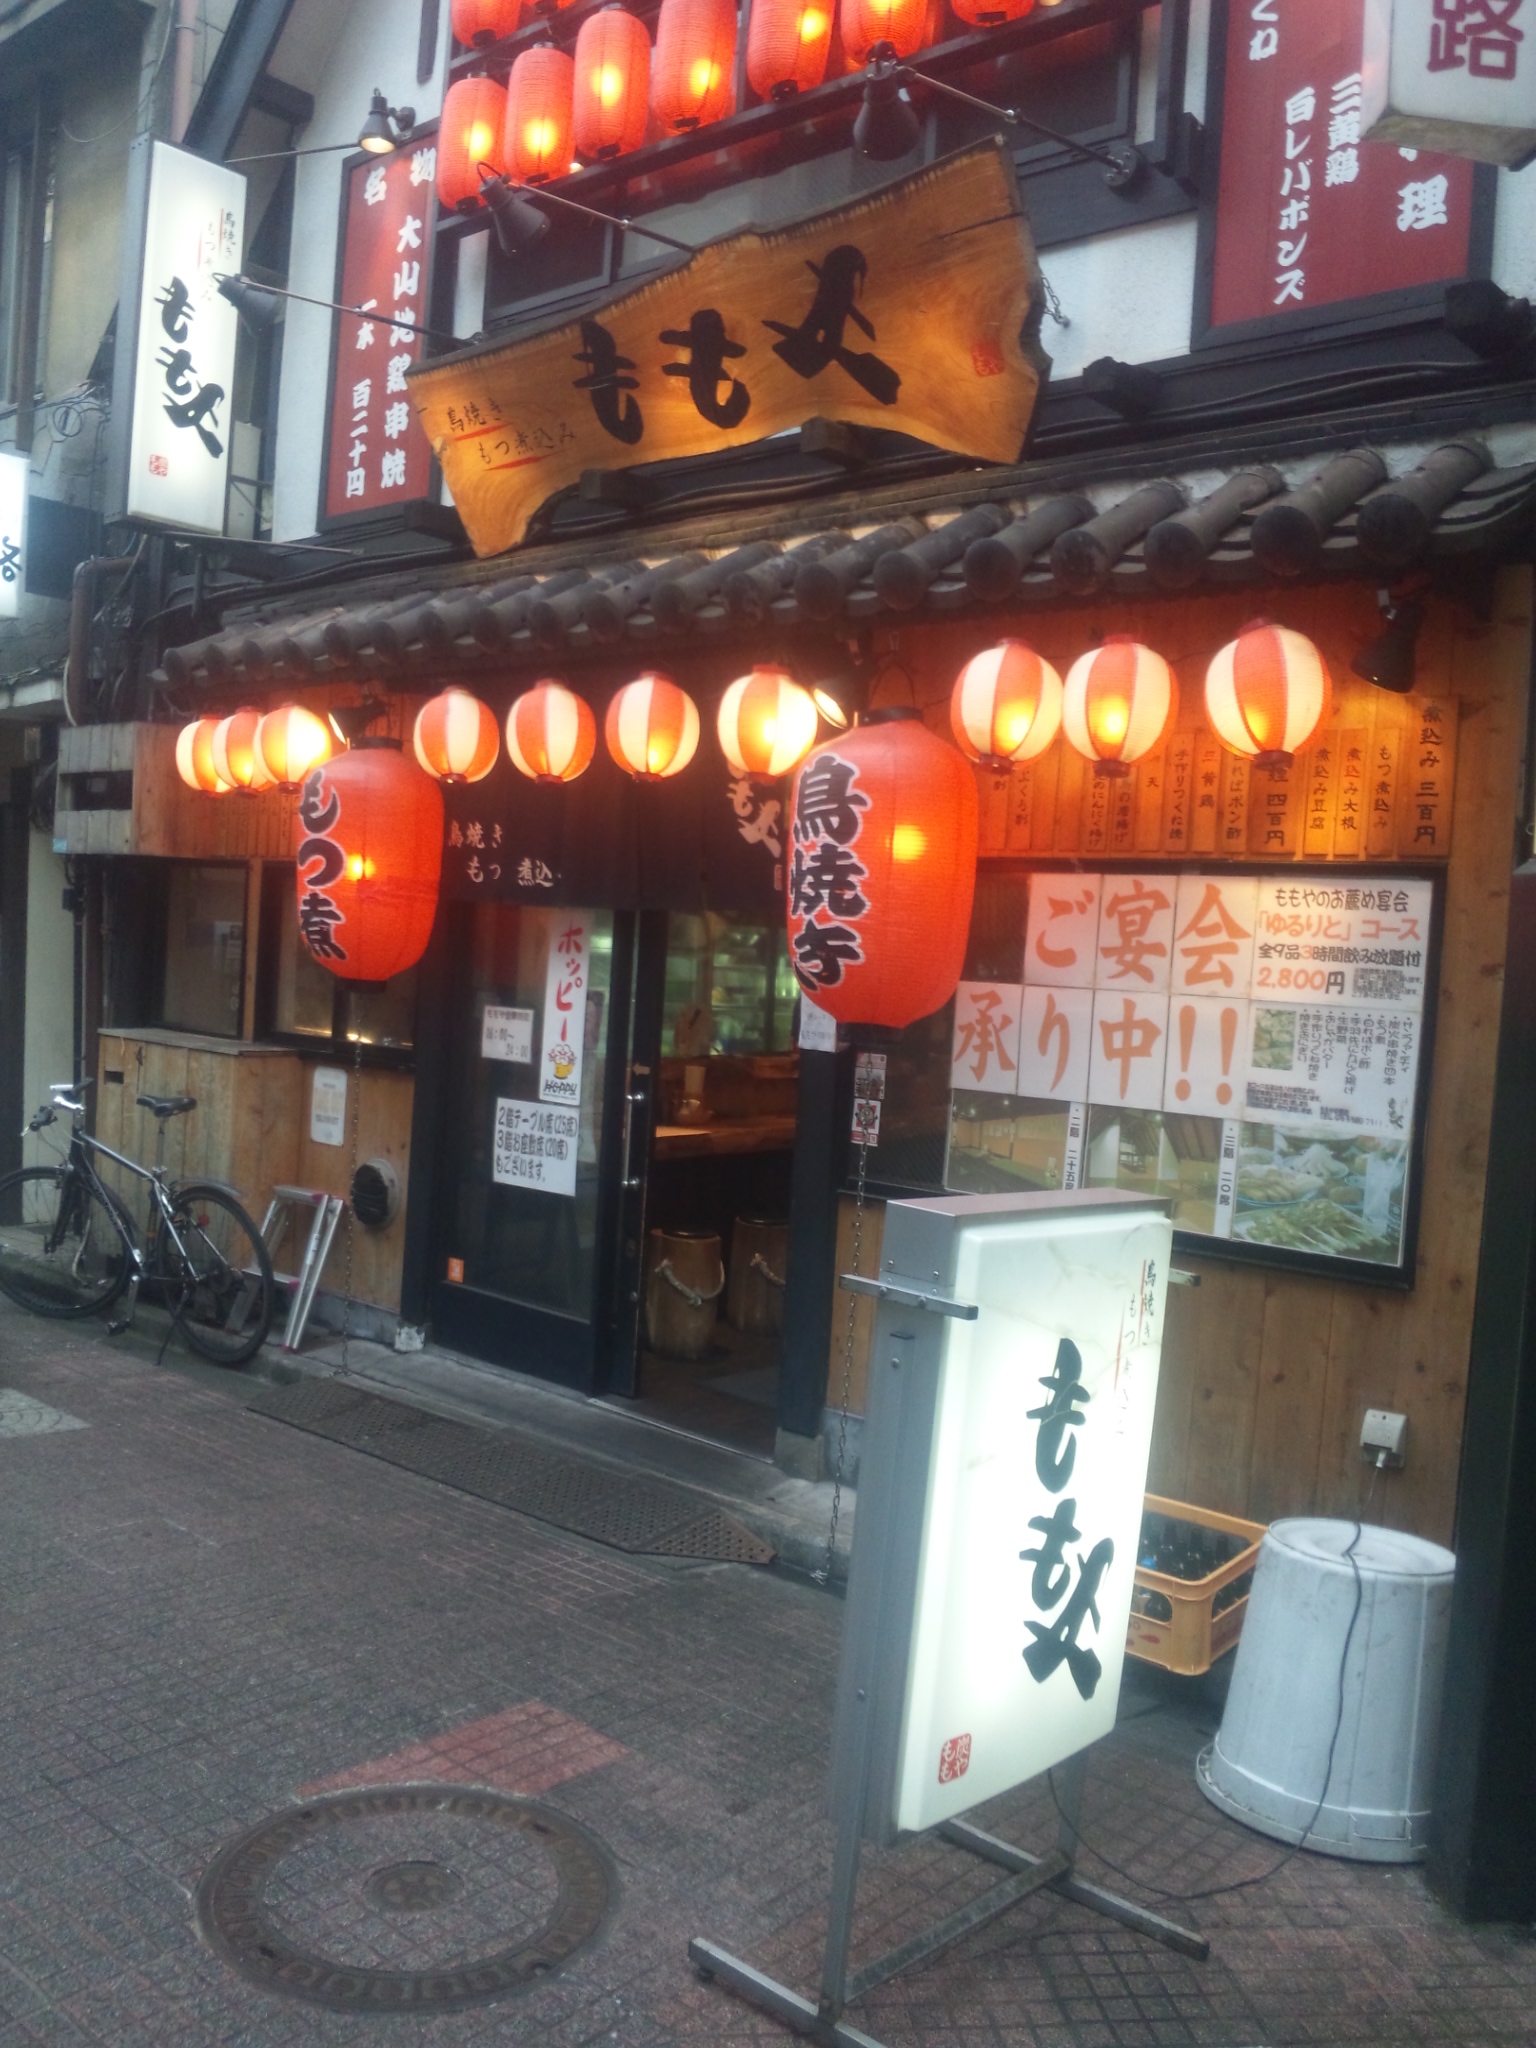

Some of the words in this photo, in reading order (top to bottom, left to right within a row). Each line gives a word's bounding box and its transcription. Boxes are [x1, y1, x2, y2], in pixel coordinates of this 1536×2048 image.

[1325, 72, 1361, 188] 三黄鶏
[153, 275, 225, 460] ももや
[380, 215, 422, 489] 大山地鶏串焼
[572, 244, 903, 446] ももや
[446, 398, 502, 432] 鳥焼き
[477, 422, 577, 465] もつ煮込み
[1225, 755, 1246, 840] ればポン酢
[1309, 747, 1331, 831] 煮込み豆腐
[1341, 747, 1362, 831] 煮込み大根
[1373, 745, 1392, 830] もつ煮込み
[297, 768, 348, 962] もつ煮
[790, 753, 873, 993] 鳥焼き
[1275, 887, 1410, 913] ももやのお薦め宴会
[1035, 879, 1253, 989] ご宴会
[1360, 917, 1421, 942] コース
[555, 923, 584, 1043] ホッピー
[1257, 966, 1346, 995] 2,800円
[1018, 1336, 1115, 1702] ももや
